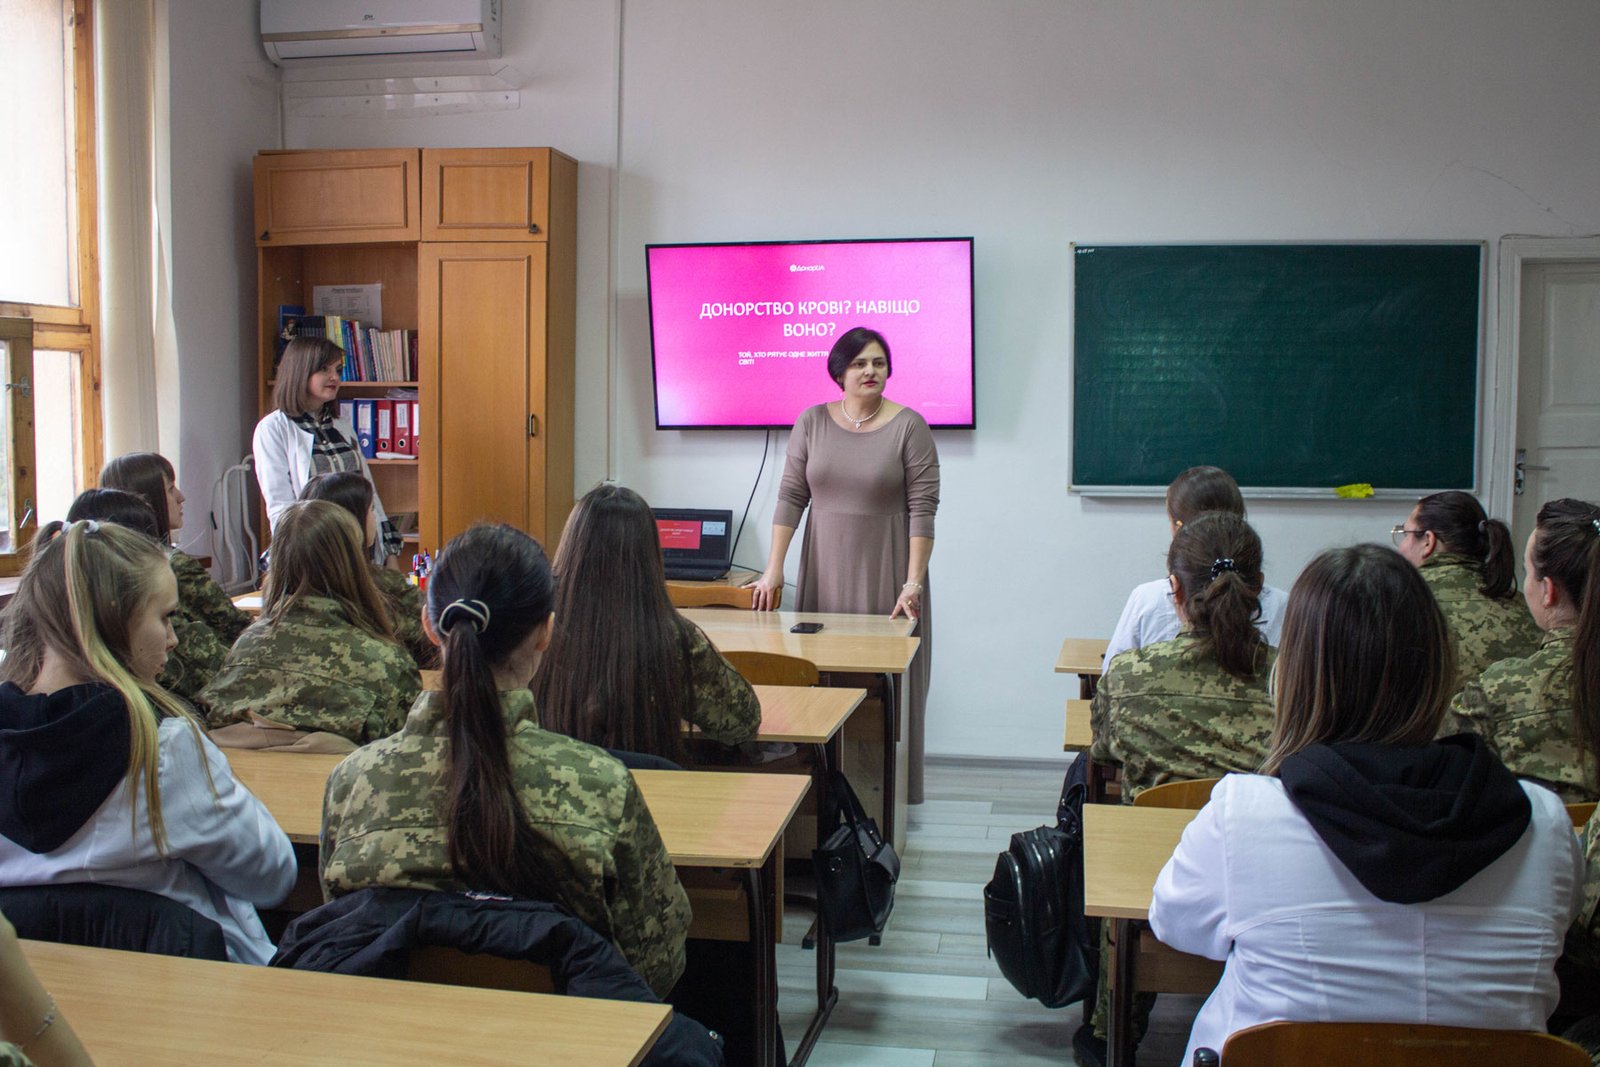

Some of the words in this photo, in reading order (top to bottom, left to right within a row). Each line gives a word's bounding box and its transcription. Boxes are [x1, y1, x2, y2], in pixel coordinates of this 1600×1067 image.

[700, 301, 794, 319] ДОНОРСТВО
[798, 300, 852, 315] КРОВІ?
[856, 299, 920, 316] НАВІЩО
[783, 322, 836, 337] ВОНО?
